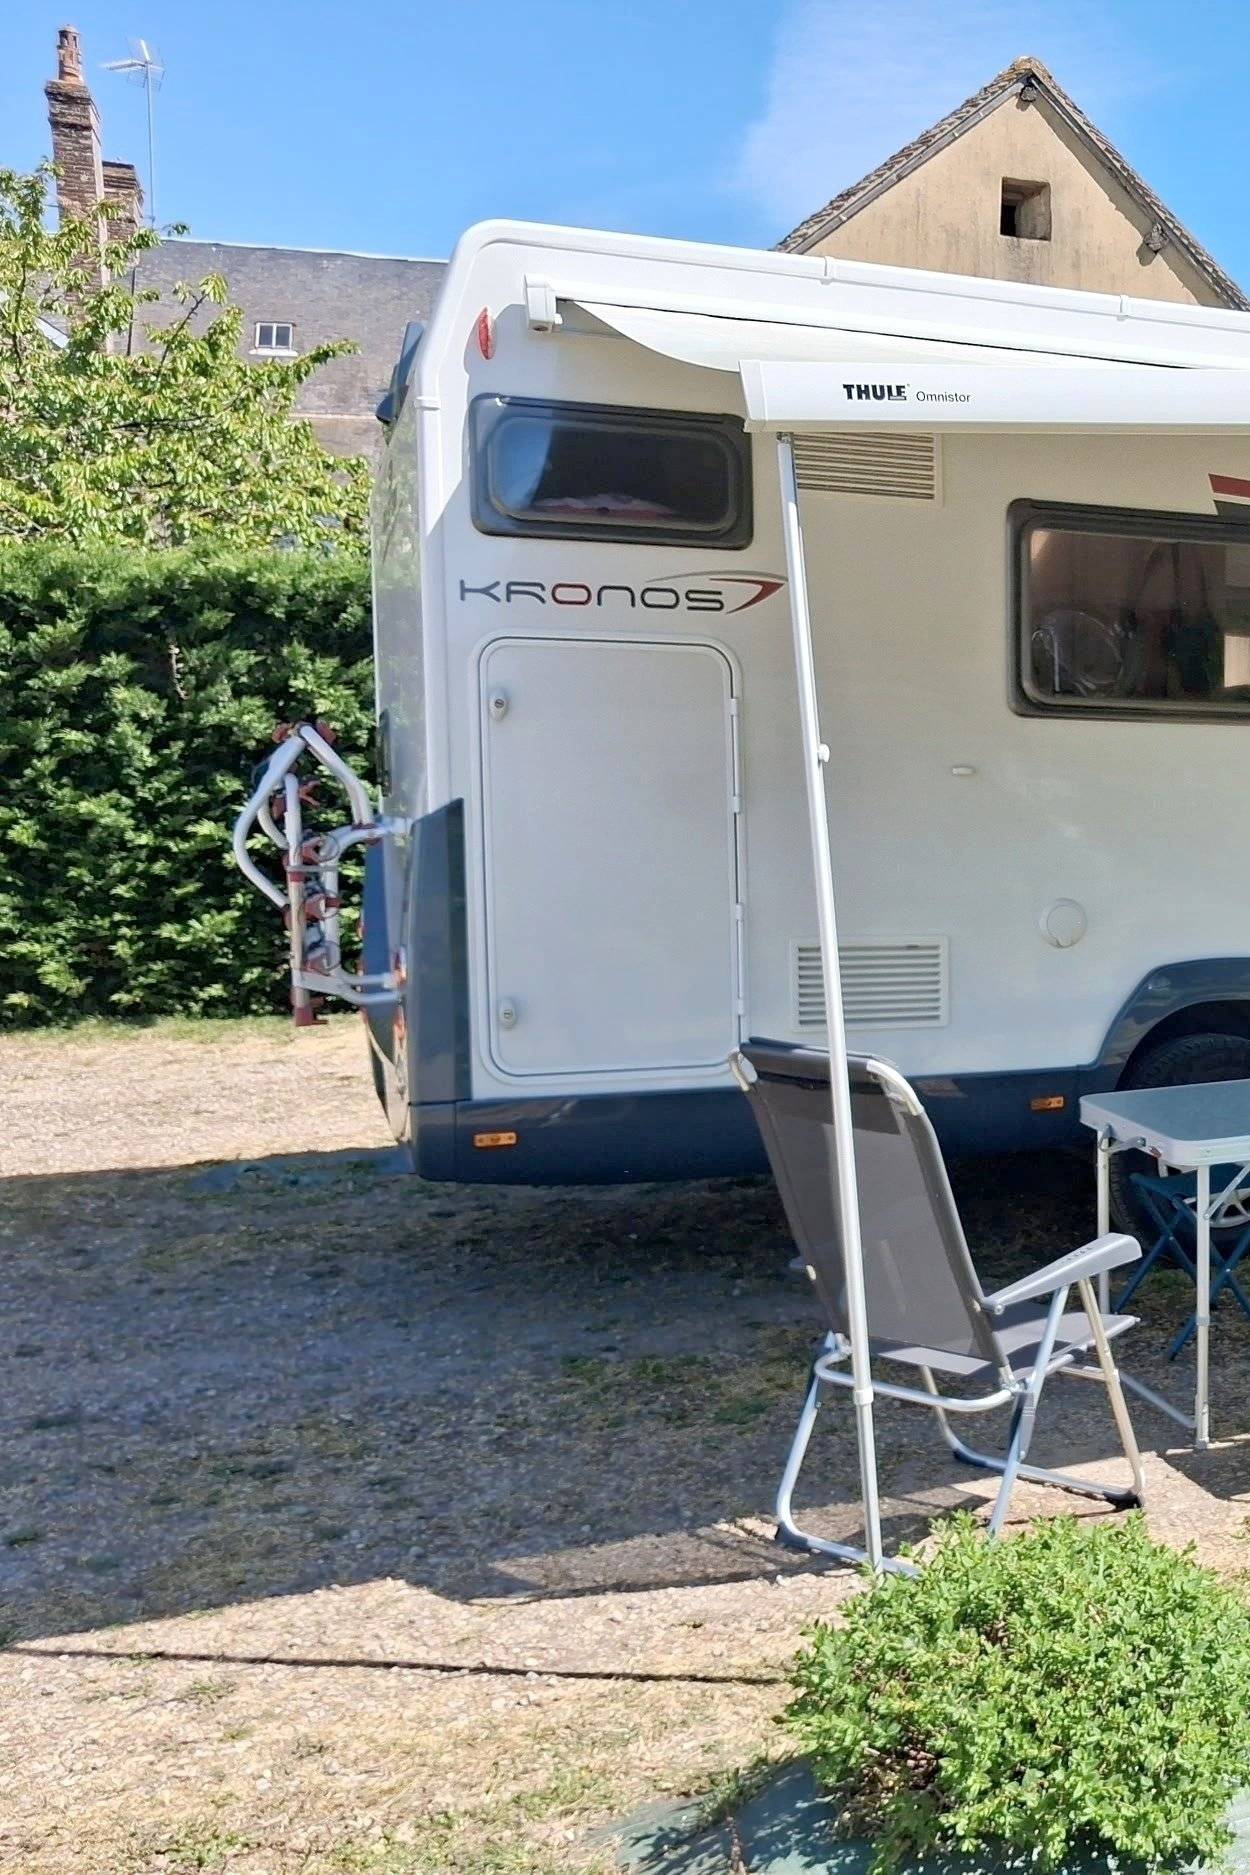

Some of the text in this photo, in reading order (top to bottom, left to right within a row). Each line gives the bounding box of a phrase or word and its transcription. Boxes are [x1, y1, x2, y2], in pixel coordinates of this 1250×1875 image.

[842, 384, 971, 403] THULE Omnistor
[459, 578, 725, 613] KRONOS
